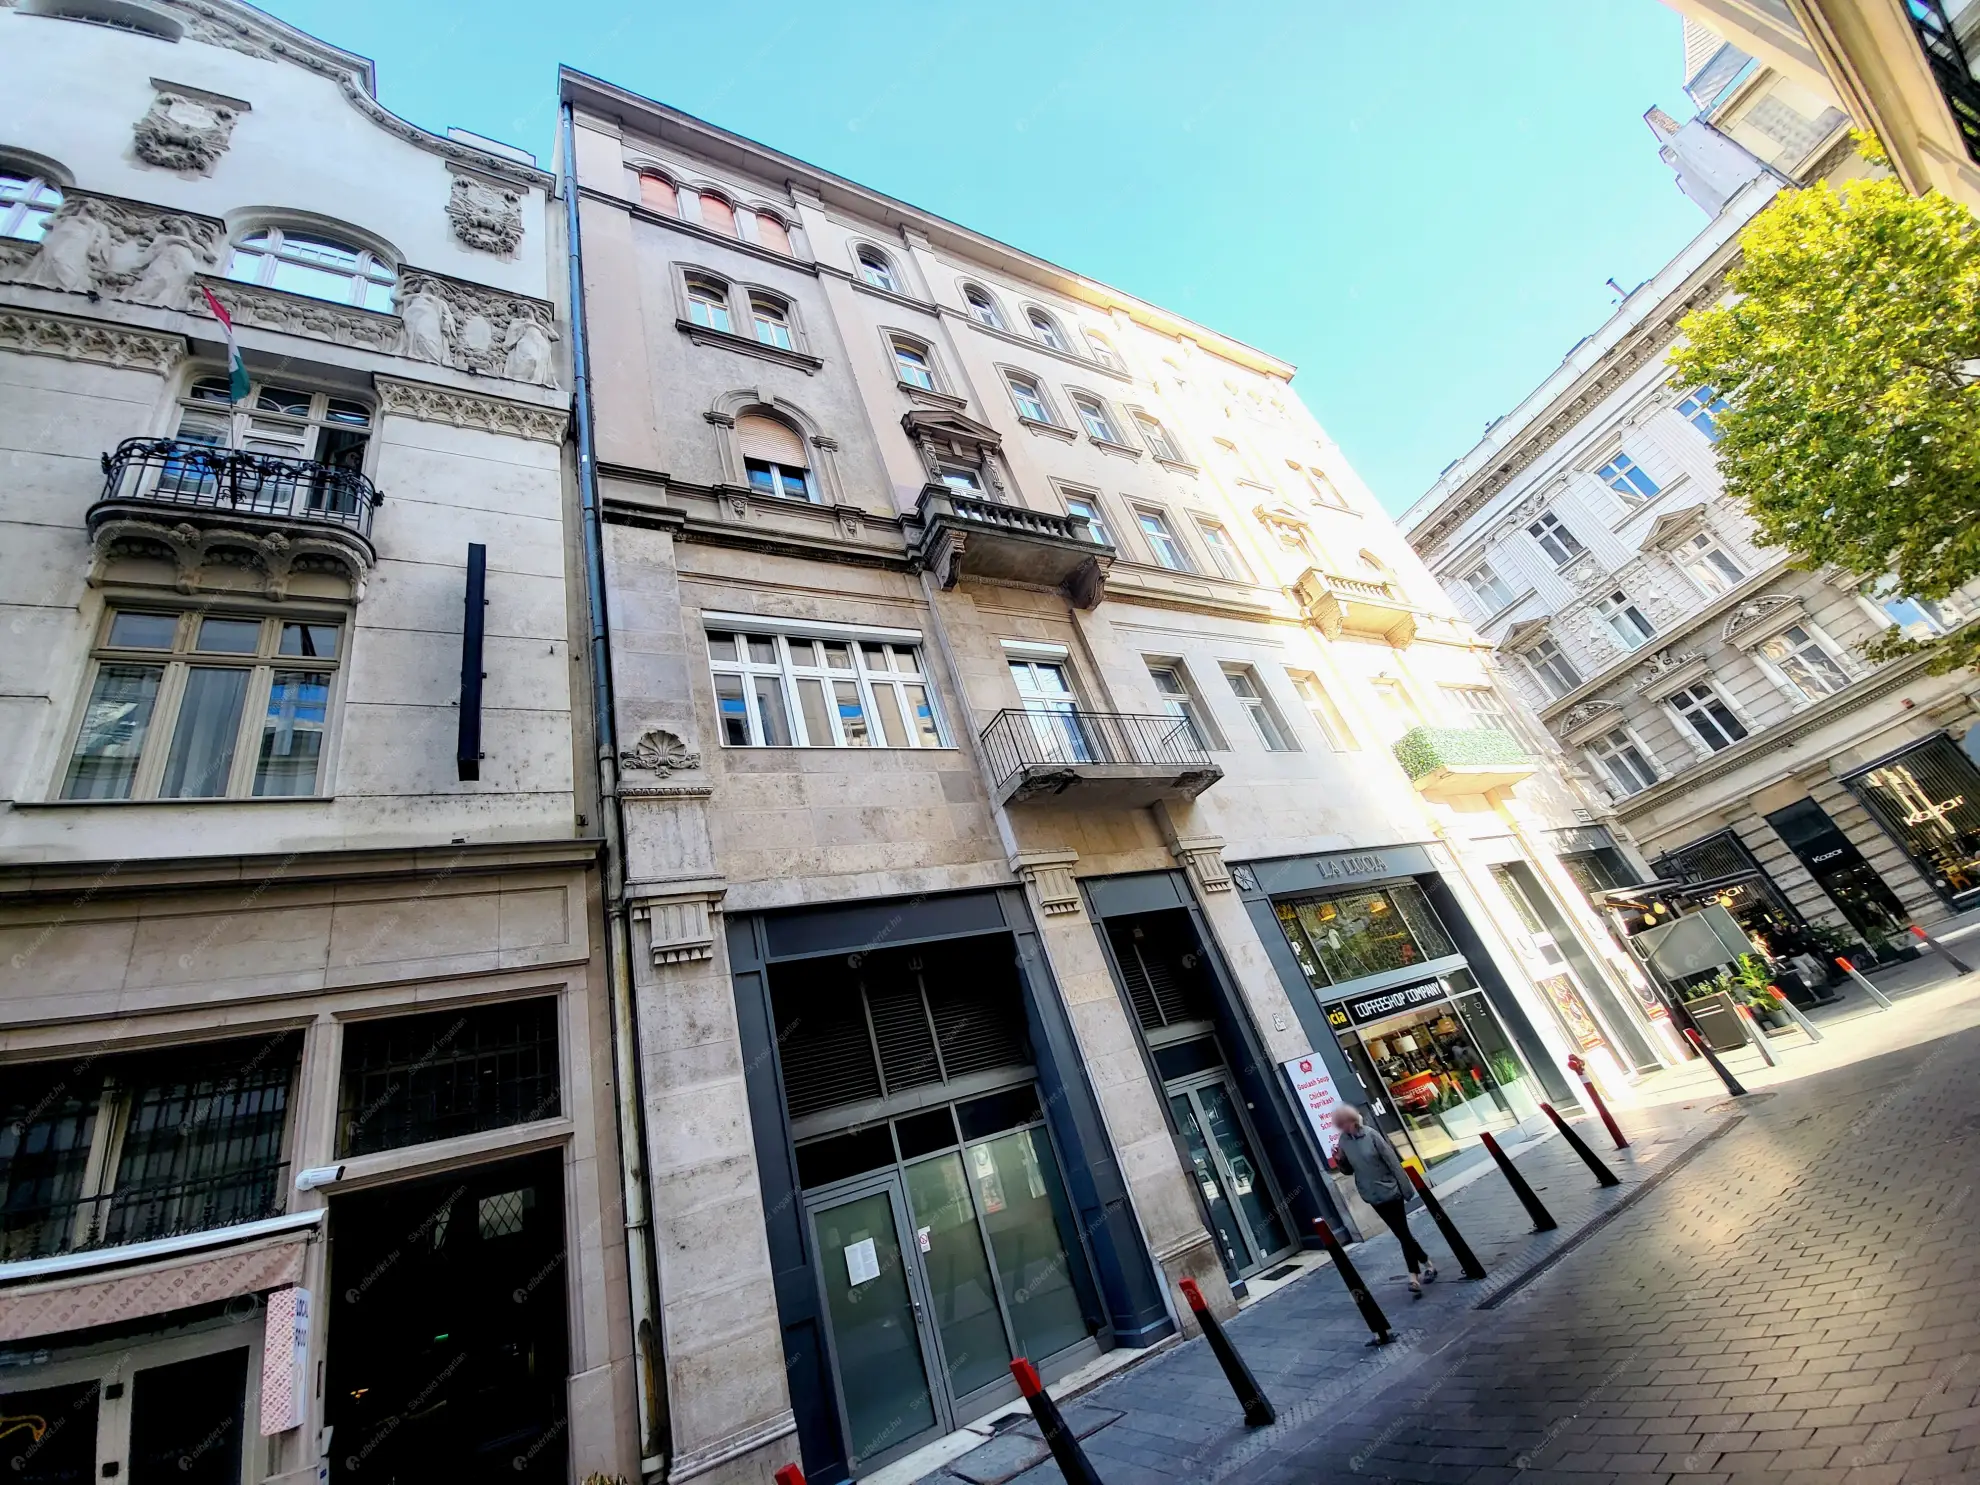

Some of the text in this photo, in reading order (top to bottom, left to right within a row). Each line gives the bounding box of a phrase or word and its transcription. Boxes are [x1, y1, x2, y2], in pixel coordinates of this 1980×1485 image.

[1902, 793, 1964, 827] Kazar
[1812, 848, 1843, 864] Kazar
[1316, 859, 1341, 879] LA
[1354, 981, 1442, 1018] COFFEESHOP COMPANY
[1328, 1009, 1347, 1025] cia
[1296, 1075, 1330, 1091] Goulash Soup
[1308, 1089, 1329, 1101] Chicken
[1310, 1096, 1335, 1110] Paprikash
